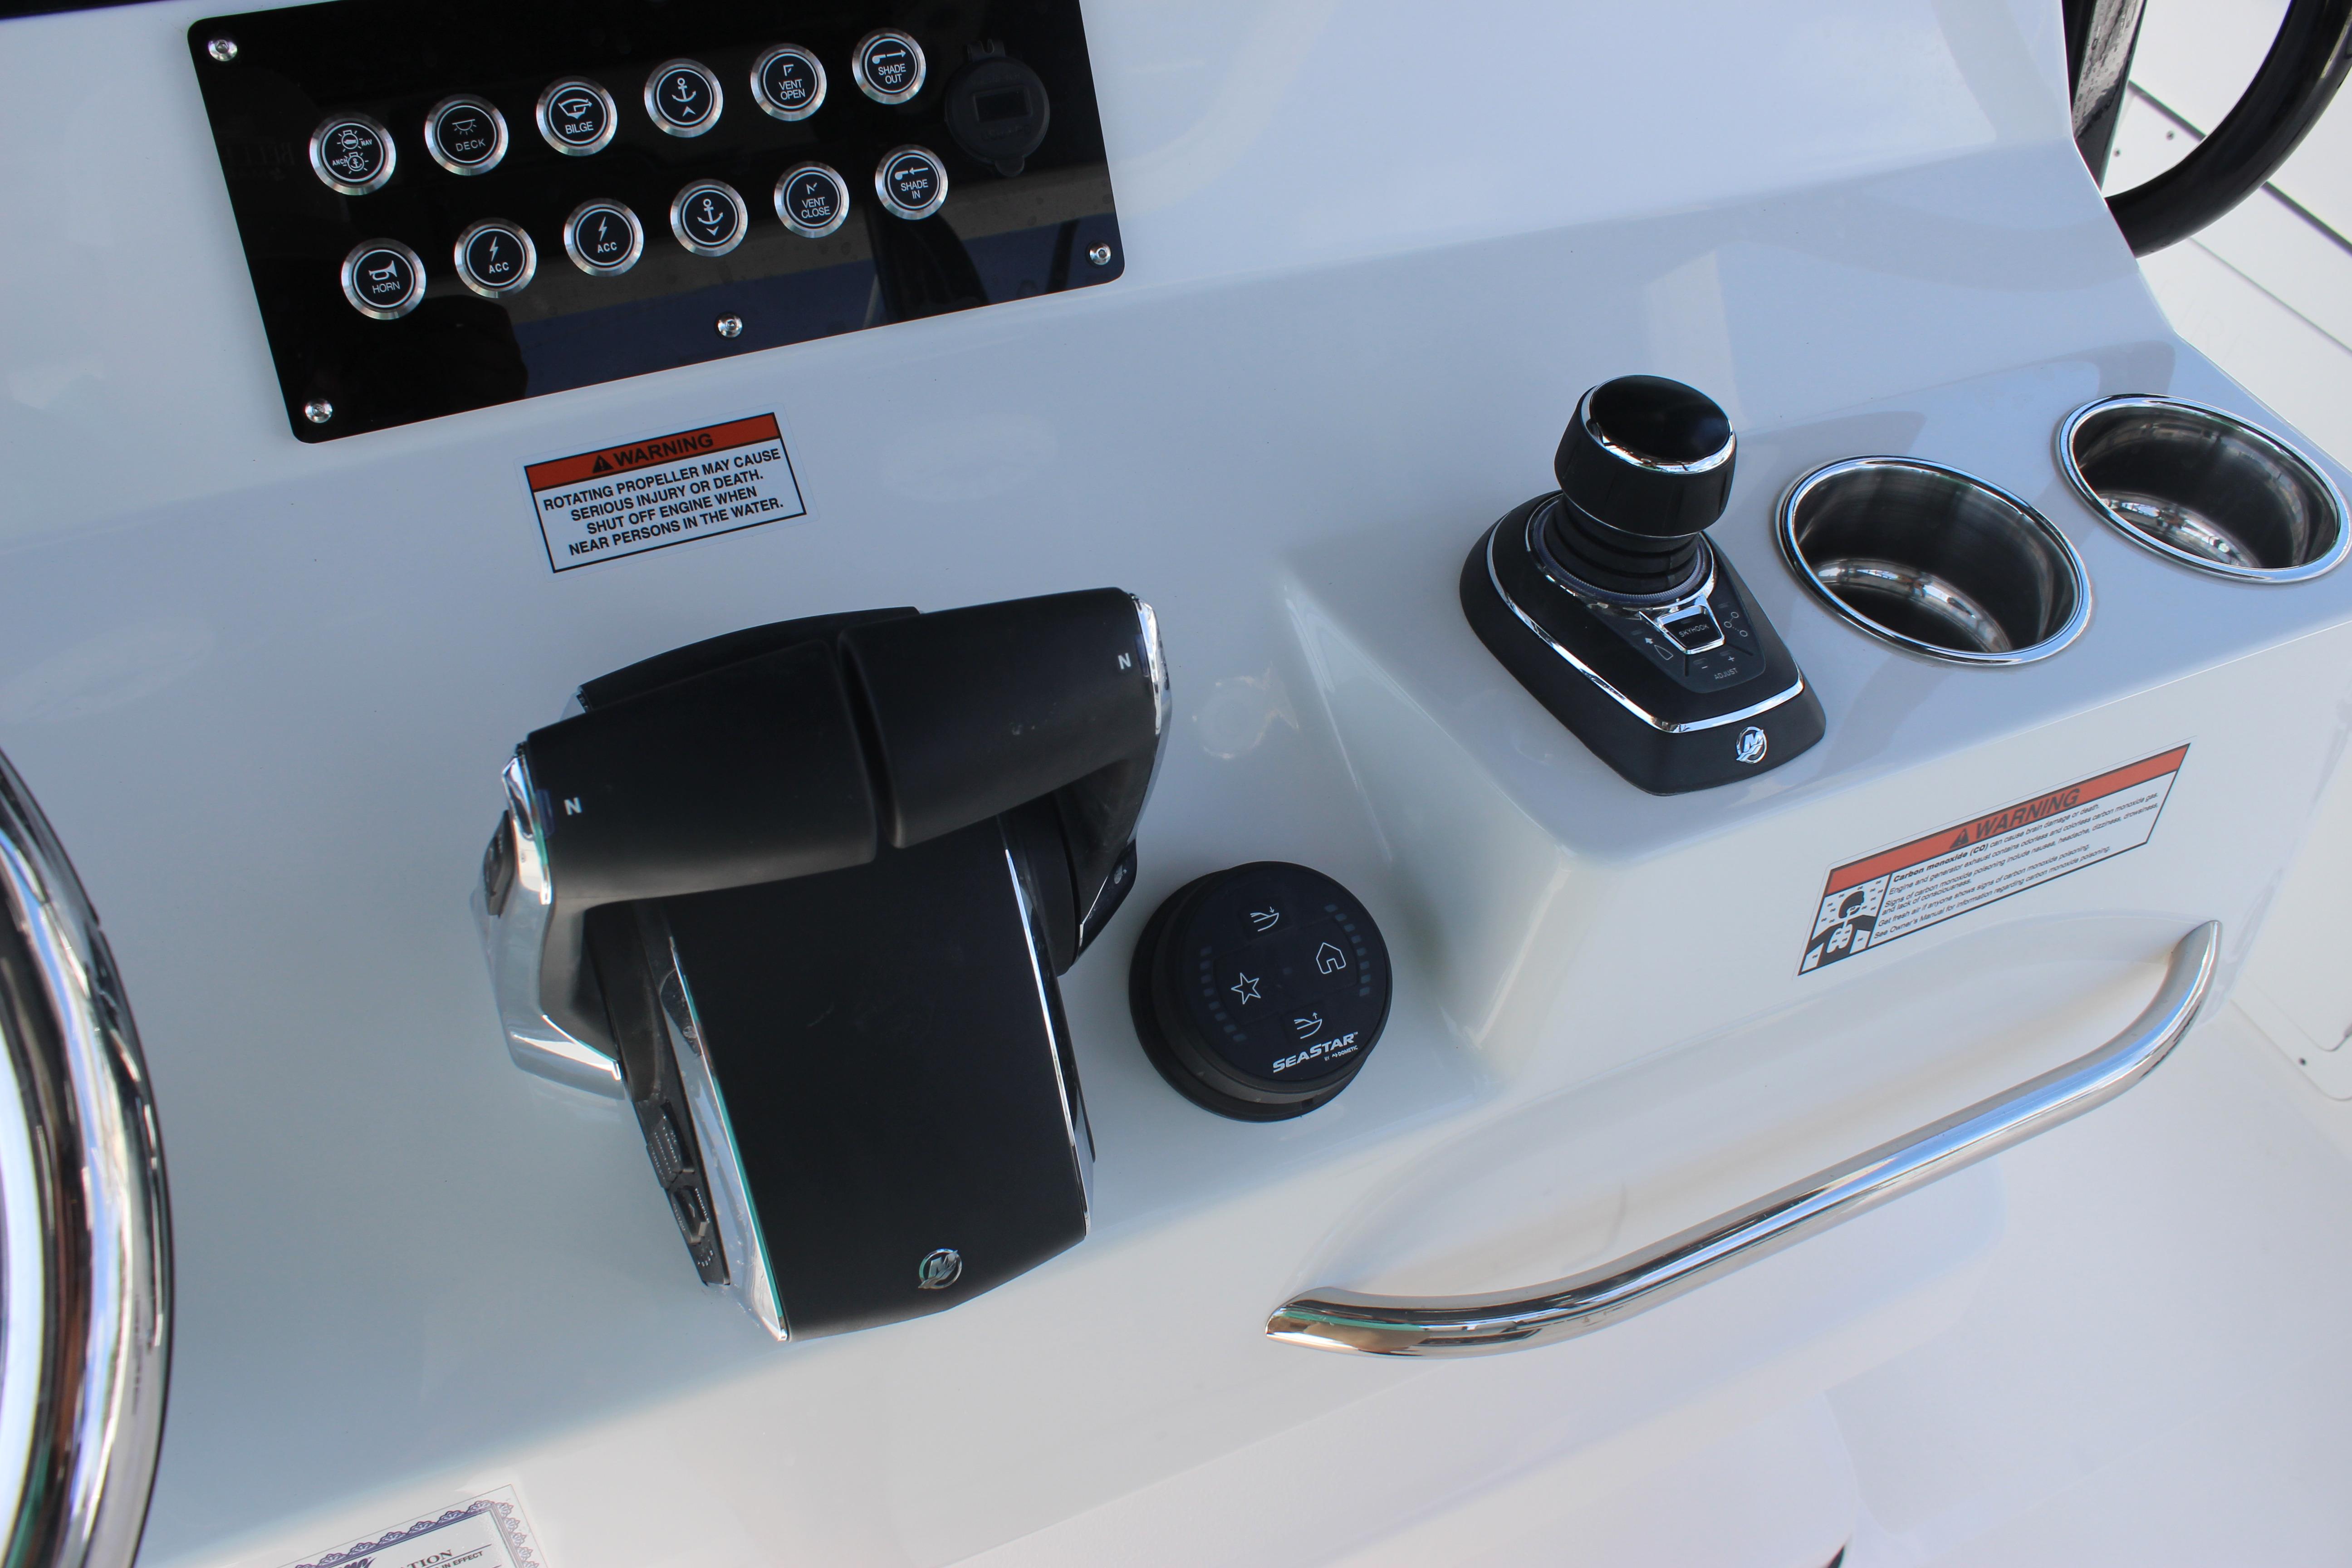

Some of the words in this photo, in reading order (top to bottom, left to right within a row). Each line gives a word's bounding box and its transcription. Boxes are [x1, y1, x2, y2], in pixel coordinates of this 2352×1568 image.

[878, 64, 906, 76] SHADE
[779, 79, 803, 91] VENT
[885, 73, 902, 84] OUT
[780, 88, 805, 100] OPEN
[565, 121, 593, 135] BILGE
[456, 138, 485, 152] DECK
[332, 157, 348, 166] ANCH
[900, 179, 929, 192] SHADE
[912, 189, 921, 199] IN
[802, 196, 826, 209] VENT
[801, 205, 831, 218] CLOSE
[597, 242, 617, 253] ACC
[489, 261, 510, 274] ACC
[372, 281, 400, 294] HORN
[613, 433, 714, 467] WARNING
[543, 485, 613, 510] ROTATING
[616, 466, 699, 494] PROPELLER
[701, 459, 729, 475] MAY
[734, 448, 780, 467] CAUSE
[570, 497, 633, 521] SERIOUS
[636, 485, 685, 506] INJURY
[690, 480, 710, 494] OR
[713, 469, 763, 489] DEATH.
[587, 515, 623, 534] SHUT
[628, 509, 655, 524] OFF
[659, 496, 712, 518] ENGINE
[714, 486, 757, 505] WHEN
[568, 537, 609, 555] NEAR
[612, 520, 680, 545] PERSONS
[682, 516, 697, 529] IN
[699, 509, 729, 524] THE
[730, 498, 783, 517] WATER.
[1679, 623, 1709, 637] SKYHOOK
[1117, 652, 1132, 670] N
[1714, 667, 1738, 680] ADJUST
[564, 797, 582, 815] N
[1976, 788, 2081, 839] WARNING
[1889, 882, 1913, 894] Engine
[1915, 875, 1929, 885] and
[1929, 864, 1963, 881] generator
[1964, 853, 1991, 867] exhaust
[1992, 843, 2019, 857] contains
[2020, 833, 2048, 847] odorless
[2049, 827, 2062, 836] and
[2063, 817, 2091, 831] colorless
[2092, 808, 2114, 820] carbon
[2115, 797, 2145, 812] monoxide
[2145, 793, 2158, 802] gas.
[1893, 867, 1925, 882] Carbon
[1926, 852, 1968, 871] monoxide
[1970, 843, 1988, 856] (CO)
[1989, 839, 2002, 847] can
[2004, 831, 2024, 842] cause
[2025, 824, 2043, 834] brain
[2043, 814, 2070, 828] damage
[2080, 804, 2099, 814] death.
[1885, 897, 1904, 907] Signs
[1914, 884, 1938, 896] carbon
[1939, 872, 1972, 887] monoxide
[1974, 859, 2005, 874] poisoning
[2007, 850, 2030, 862] include
[2031, 841, 2056, 853] nausea,
[2059, 828, 2090, 842] headache,
[2092, 817, 2122, 831] dizziness,
[2123, 803, 2158, 819] drowsiness,
[1874, 930, 1888, 938] See
[1890, 918, 1918, 932] Owner's
[1919, 907, 1945, 921] Manual
[1956, 891, 1993, 907] information
[1994, 878, 2024, 893] regarding
[2025, 870, 2047, 882] carbon
[2048, 858, 2078, 872] monoxide
[2079, 846, 2110, 862] poisoning.
[1878, 917, 1891, 926] Get
[1892, 911, 1910, 921] fresh
[1927, 896, 1952, 908] anyone
[1954, 887, 1975, 898] shows
[1976, 880, 1994, 890] signs
[1995, 875, 2004, 883] of
[2003, 868, 2025, 880] carbon
[2027, 856, 2058, 871] monoxide
[2058, 844, 2090, 860] poisoning.
[1882, 906, 1895, 915] and
[1896, 901, 1911, 910] lack
[1921, 879, 1971, 901] consciousness.
[1338, 1045, 1358, 1057] DOMETIC
[454, 1551, 483, 1566] EFFECT
